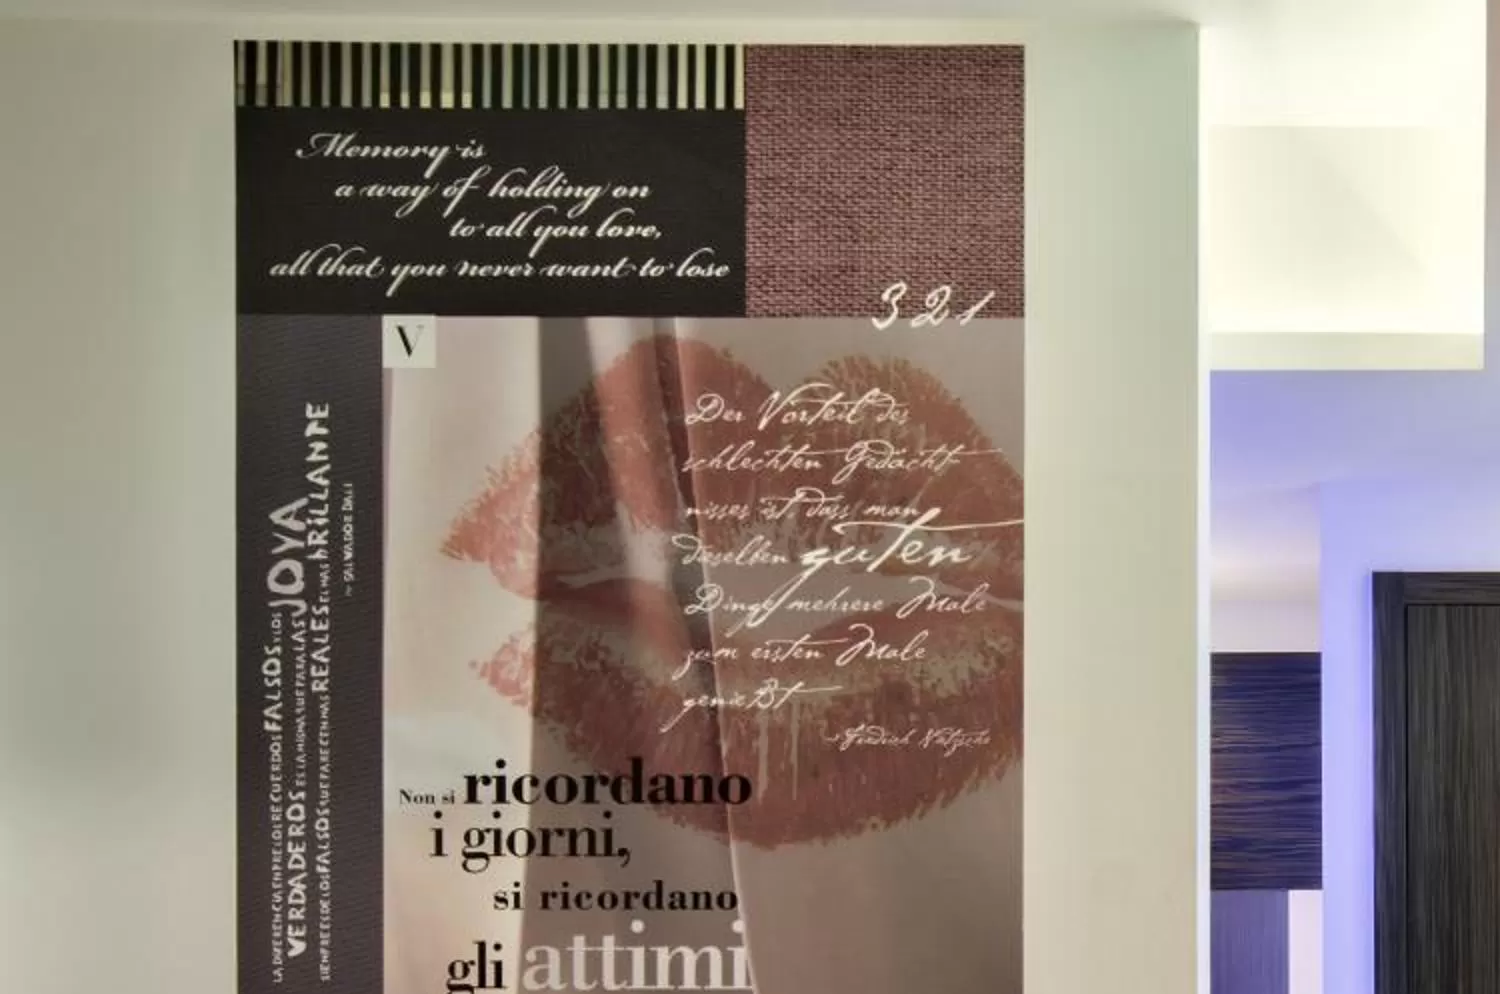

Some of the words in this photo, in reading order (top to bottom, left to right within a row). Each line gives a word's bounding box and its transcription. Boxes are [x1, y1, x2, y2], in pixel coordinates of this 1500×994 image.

[295, 132, 451, 179] Memory
[455, 140, 485, 158] is
[334, 184, 354, 197] a
[359, 183, 439, 218] way
[441, 165, 491, 218] of
[486, 165, 611, 219] holding
[612, 183, 652, 198] on
[449, 218, 485, 237] to
[484, 204, 557, 238] all
[528, 224, 590, 259] you
[594, 207, 662, 239] love,
[269, 243, 342, 277] all
[316, 246, 385, 278] that
[386, 262, 447, 298] you
[454, 259, 534, 278] never
[540, 257, 637, 278] want
[639, 257, 675, 278] to
[675, 247, 731, 278] lose
[395, 323, 425, 358] V
[685, 394, 745, 425] Der
[757, 383, 878, 430] Vorteil
[682, 440, 822, 473] schlechten
[863, 505, 922, 518] man
[266, 497, 309, 617] JOYA
[788, 587, 884, 613] mehrere
[895, 576, 990, 619] Male
[290, 619, 307, 652] LAS
[309, 604, 331, 693] REALES
[752, 634, 823, 664] ersten
[835, 623, 929, 666] Male
[261, 645, 283, 731] FALSOS
[269, 735, 283, 821] RECUERDOS
[399, 788, 436, 806] Non
[441, 788, 456, 805] si
[463, 756, 753, 806] ricordano
[314, 807, 331, 873] FALSOS
[429, 810, 449, 858] i
[461, 810, 632, 874] giorni,
[285, 790, 308, 957] VERDADEROS
[492, 881, 526, 911] si
[539, 879, 739, 912] ricordano
[522, 919, 754, 991] attimi
